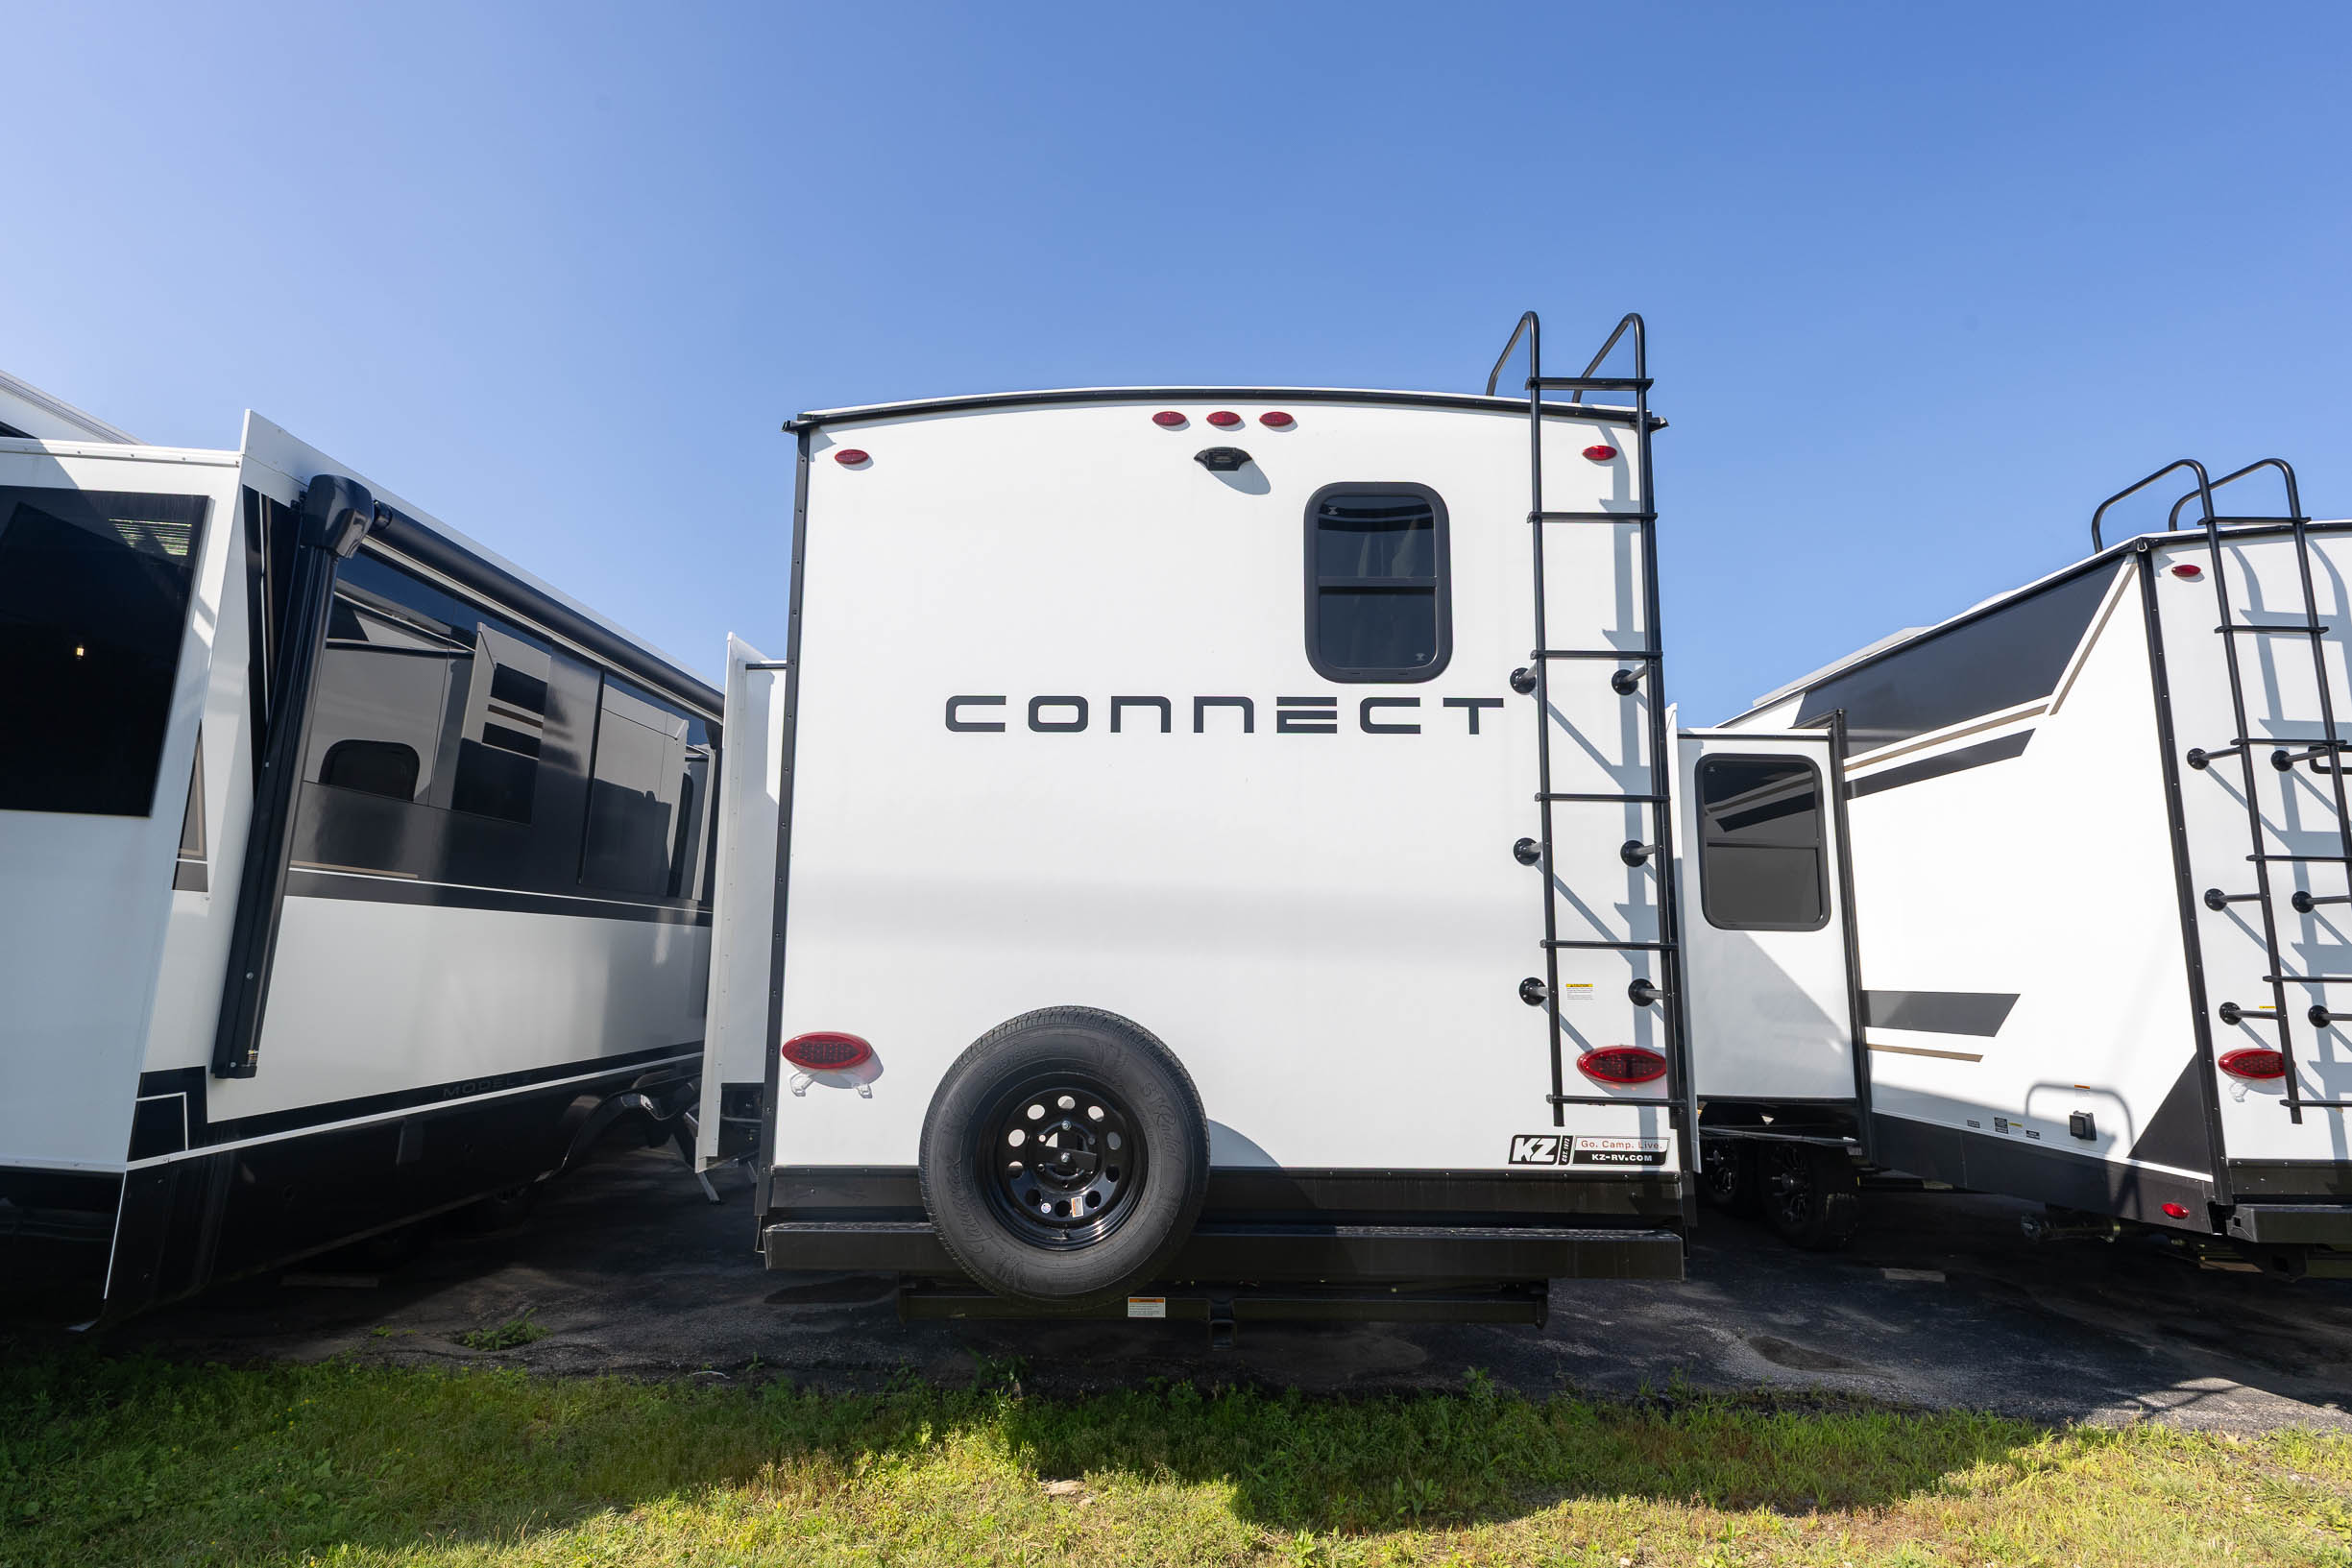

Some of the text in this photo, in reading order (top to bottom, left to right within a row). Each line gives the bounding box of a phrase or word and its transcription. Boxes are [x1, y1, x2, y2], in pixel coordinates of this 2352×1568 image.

[945, 695, 1504, 736] CONNECT
[443, 1076, 516, 1098] MODEL
[1512, 1137, 1557, 1162] KZ
[1581, 1139, 1662, 1149] Go. Camp. Live.
[1591, 1153, 1653, 1162] KZ-RV.COM
